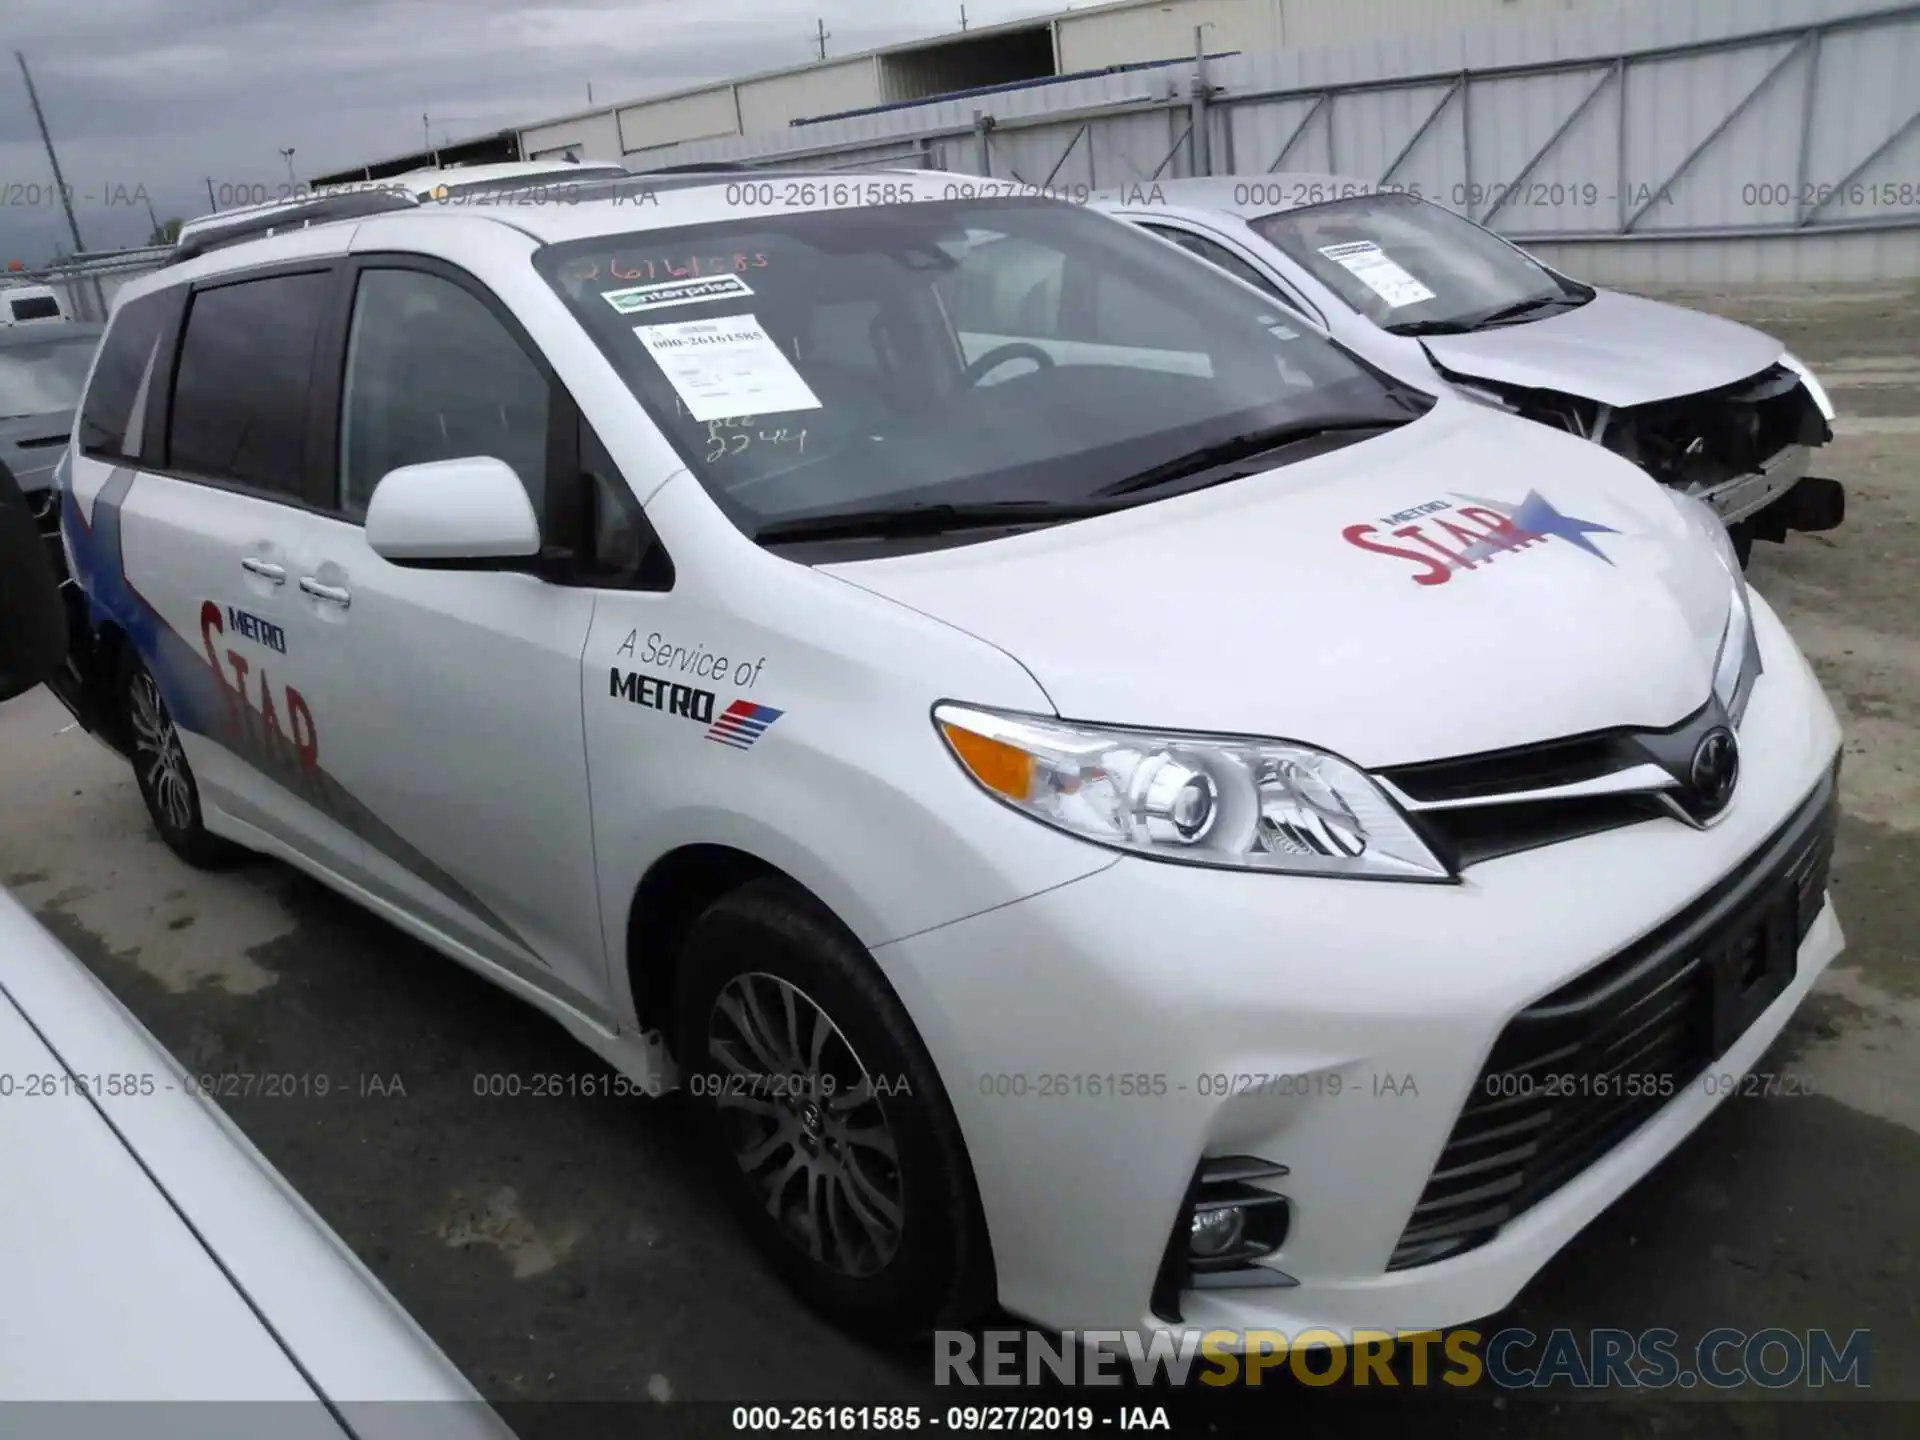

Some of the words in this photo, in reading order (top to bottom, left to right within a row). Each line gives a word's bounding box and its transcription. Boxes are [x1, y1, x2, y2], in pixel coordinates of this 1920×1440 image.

[1380, 499, 1453, 526] METRO
[1342, 506, 1548, 586] STAR
[228, 606, 287, 655] METRO
[616, 628, 637, 659] A
[641, 632, 729, 681] Service
[734, 657, 766, 689] of
[609, 666, 716, 725] METRO
